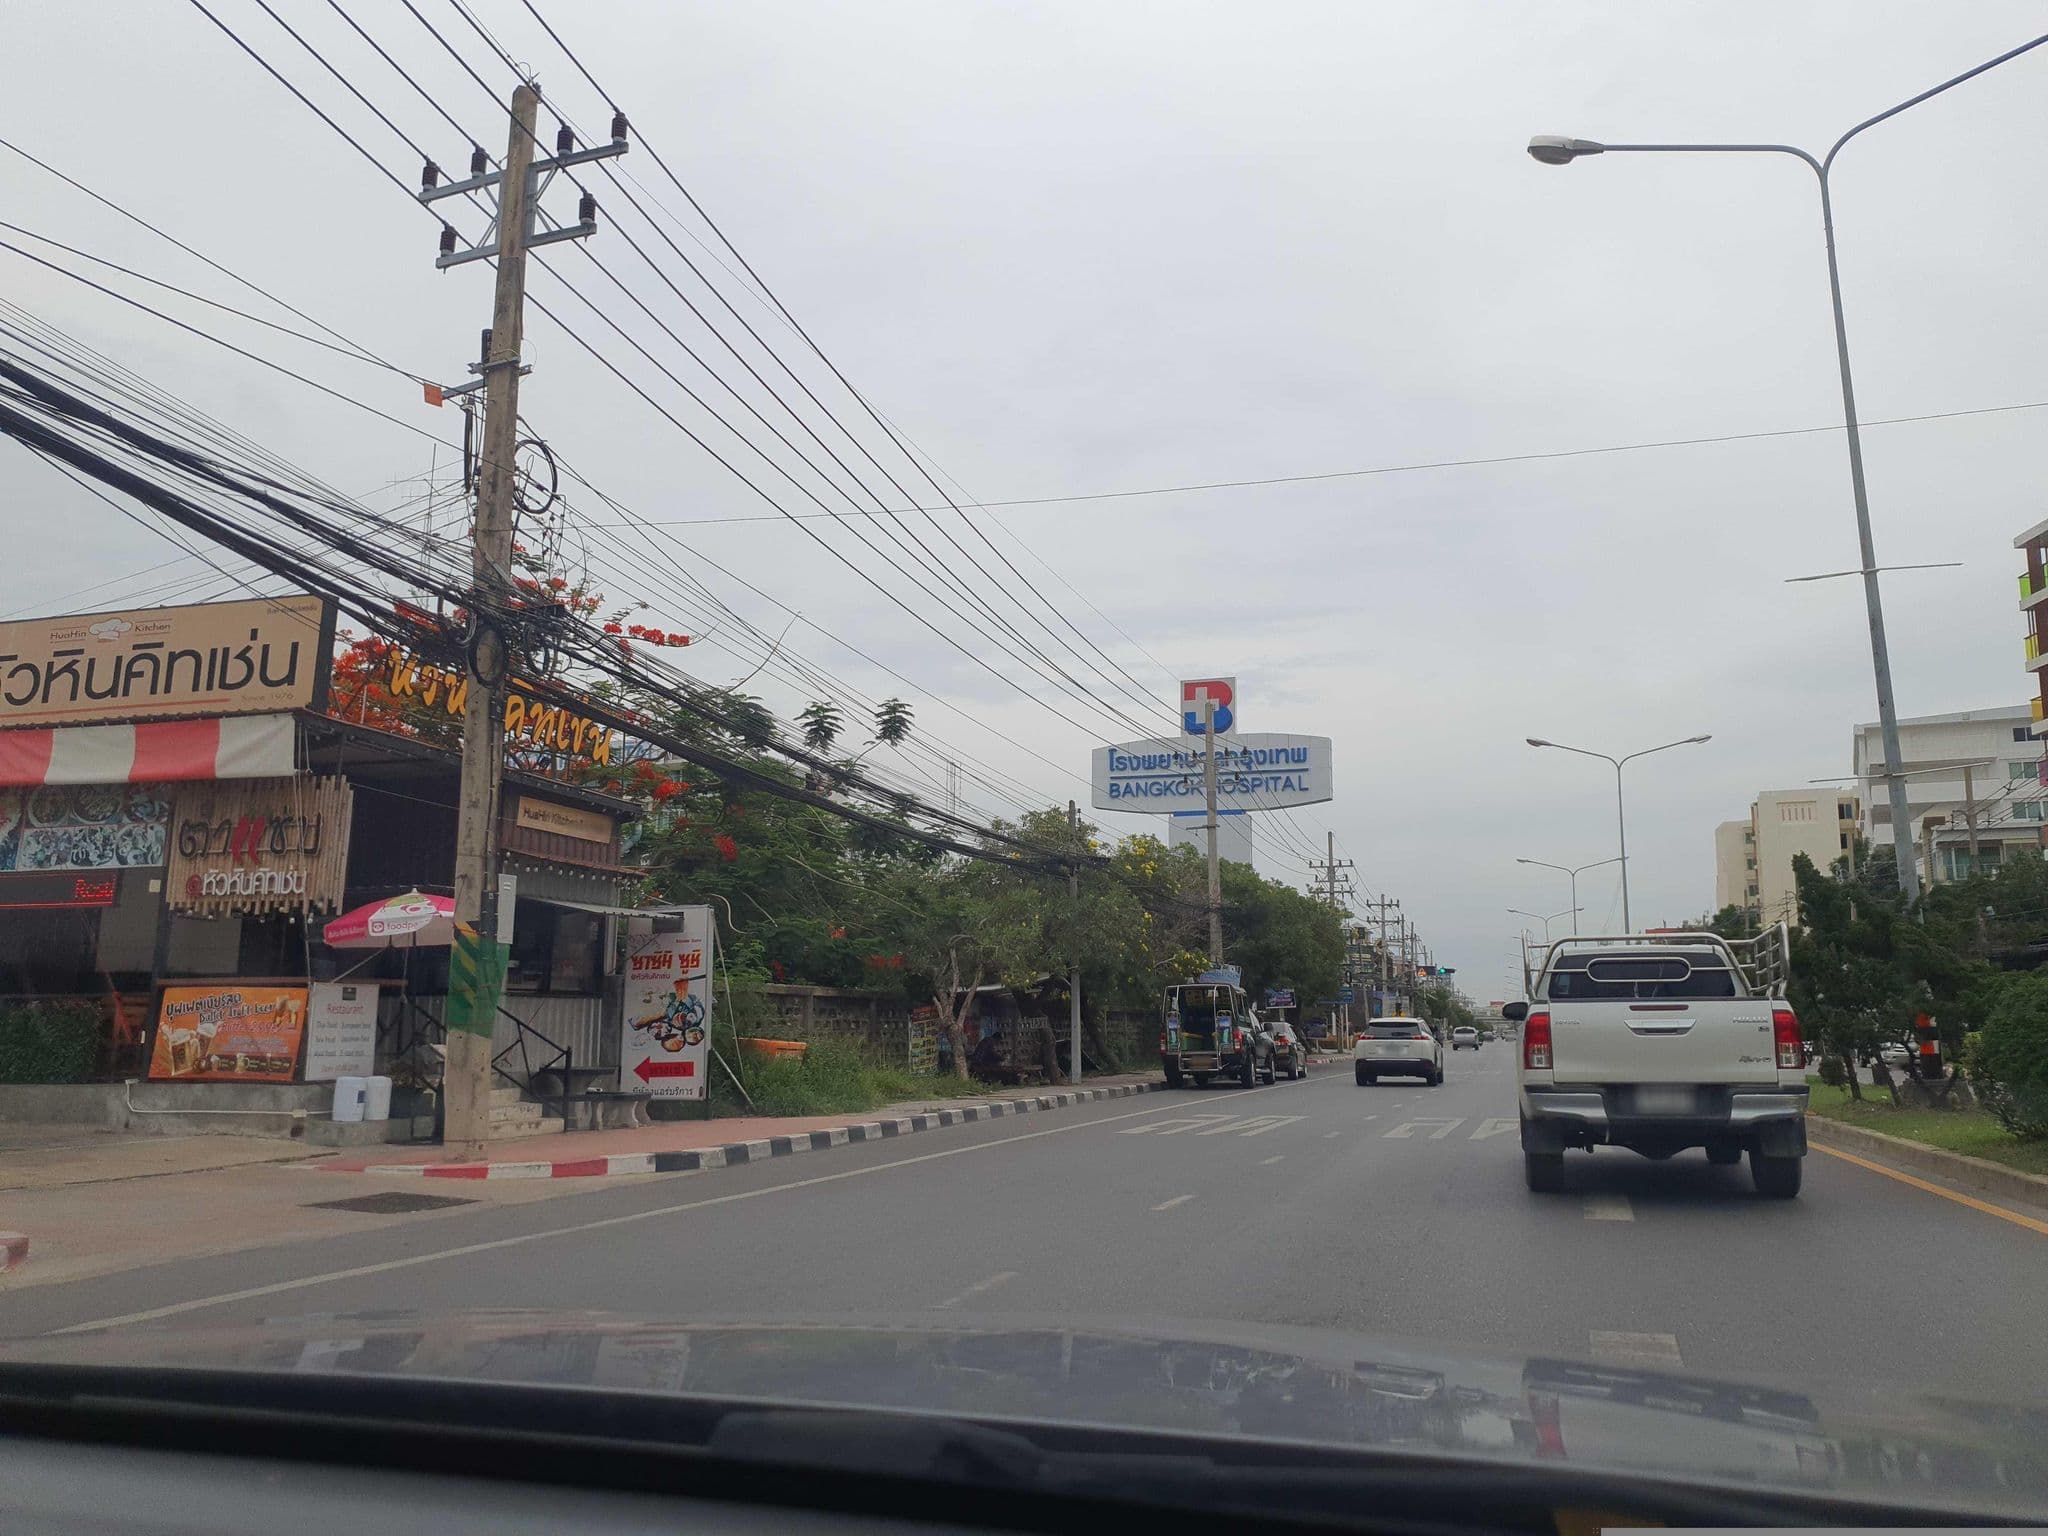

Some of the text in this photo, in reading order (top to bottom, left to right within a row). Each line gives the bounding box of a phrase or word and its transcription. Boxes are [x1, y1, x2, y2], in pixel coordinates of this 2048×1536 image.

[50, 622, 171, 640] HuaHin Kitchen
[0, 628, 299, 706] ัวหินคิทเช่น
[1110, 779, 1206, 799] BANGKOK
